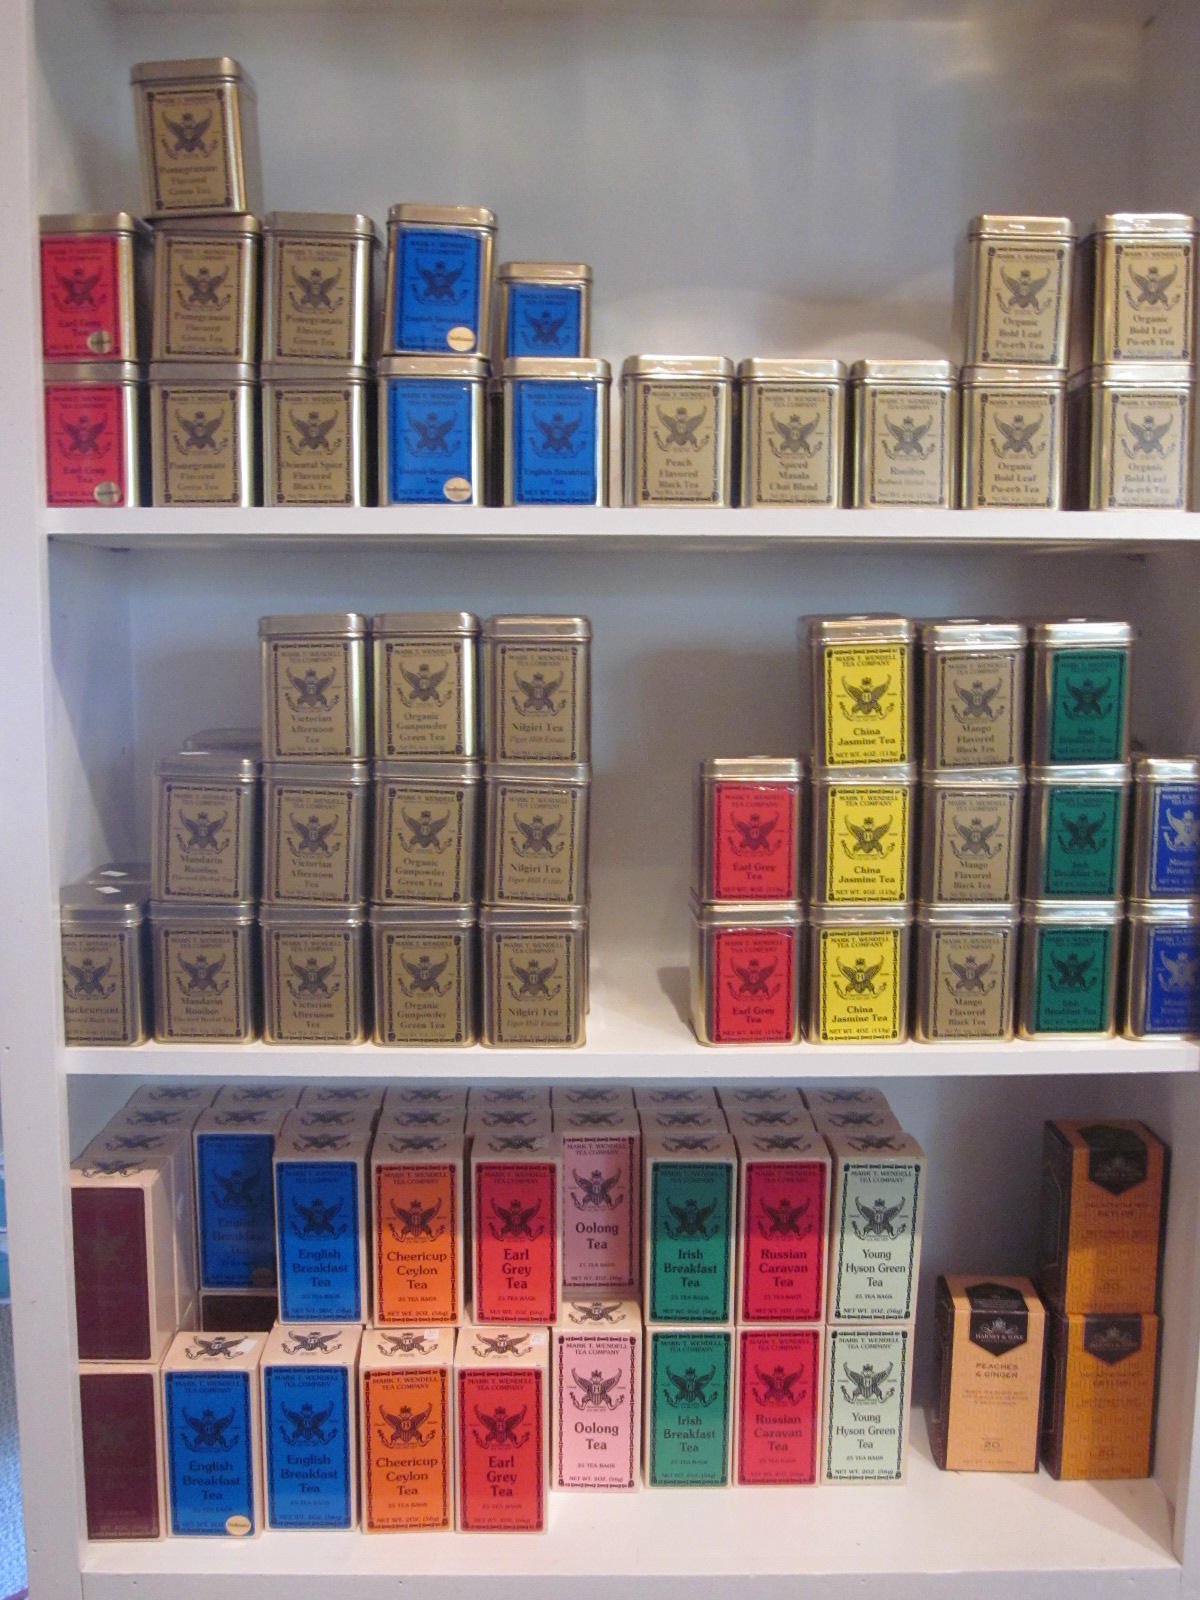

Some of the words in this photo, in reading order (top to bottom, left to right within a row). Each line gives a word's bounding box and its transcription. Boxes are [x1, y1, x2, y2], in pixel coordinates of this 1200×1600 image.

[404, 712, 439, 721] Organic
[396, 722, 447, 731] Gunpowder
[511, 723, 542, 733] Nilgiri
[546, 723, 563, 732] Tea
[853, 727, 881, 736] China
[399, 733, 426, 742] Green
[838, 738, 877, 746] Jasmine
[880, 737, 896, 745] Tea
[733, 863, 752, 871] Earl
[754, 864, 776, 873] Grey
[854, 866, 881, 874] China
[746, 872, 762, 880] Tea
[839, 875, 877, 884] Jasmine
[880, 875, 895, 883] Tea
[404, 1001, 439, 1010] Organic
[846, 1006, 874, 1014] China
[397, 1012, 448, 1020] Gunpowder
[508, 1008, 538, 1017] Nilgiri
[753, 1007, 775, 1016] Grey
[831, 1015, 870, 1024] Jasmine
[575, 1222, 619, 1235] Oolong
[586, 1238, 608, 1250] Tea
[298, 1249, 341, 1261] English
[386, 1251, 448, 1262] Cheericup
[504, 1249, 529, 1260] Earl
[678, 1248, 703, 1259] Irish
[761, 1249, 807, 1259] Russian
[862, 1249, 892, 1260] Young
[292, 1263, 348, 1273] Breakfast
[396, 1266, 438, 1278] Ceylon
[502, 1263, 531, 1277] Grey
[664, 1263, 717, 1274] Breakfast
[759, 1262, 808, 1273] Caravan
[845, 1263, 875, 1274] Hyson
[877, 1263, 906, 1273] Green
[310, 1277, 331, 1287] Tea
[407, 1280, 428, 1290] Tea
[506, 1277, 528, 1289] Tea
[680, 1277, 700, 1288] Tea
[772, 1277, 793, 1287] Tea
[866, 1276, 883, 1287] Tea
[678, 1415, 702, 1426] Irish
[756, 1414, 801, 1424] Russian
[851, 1412, 881, 1423] Young
[574, 1422, 619, 1436] Oolong
[663, 1428, 716, 1439] Breakfast
[754, 1427, 802, 1438] Caravan
[836, 1426, 865, 1437] Hyson
[868, 1426, 896, 1435] Green
[585, 1438, 608, 1450] Tea
[680, 1442, 699, 1452] Tea
[768, 1441, 788, 1451] Tea
[857, 1439, 873, 1449] Tea
[287, 1454, 331, 1466] English
[376, 1456, 438, 1468] Cheericup
[488, 1456, 514, 1468] Earl
[189, 1461, 233, 1473] English
[281, 1469, 339, 1480] Breakfast
[386, 1472, 428, 1483] Ceylon
[486, 1471, 517, 1486] Grey
[183, 1475, 240, 1486] Breakfast
[300, 1483, 320, 1493] Tea
[396, 1486, 418, 1496] Tea
[491, 1485, 514, 1497] Tea
[202, 1490, 223, 1500] Tea
